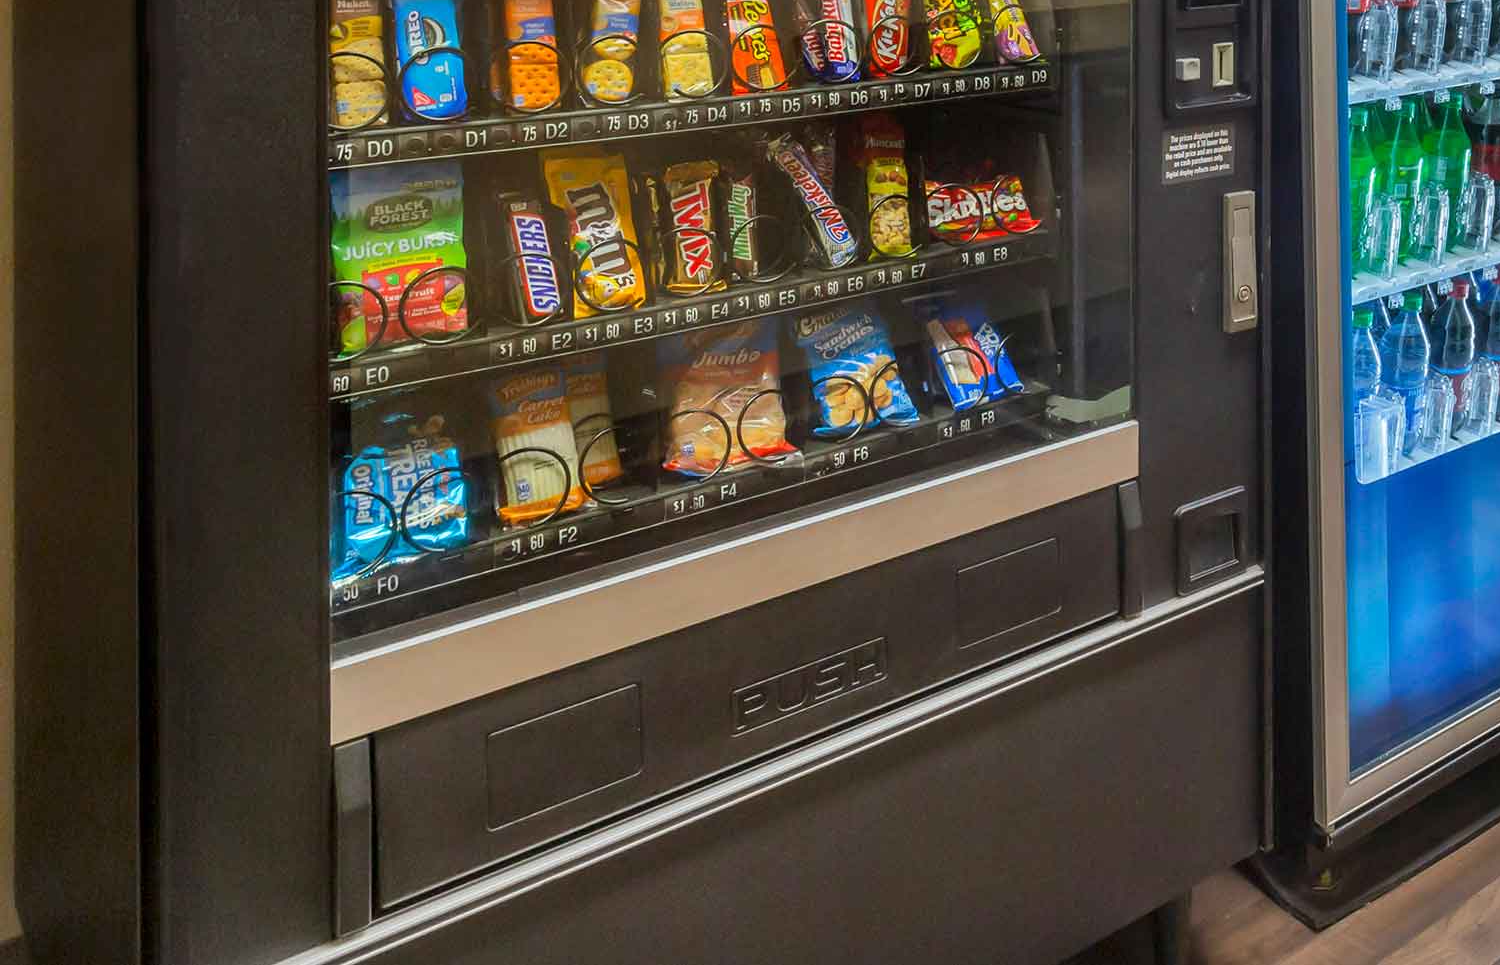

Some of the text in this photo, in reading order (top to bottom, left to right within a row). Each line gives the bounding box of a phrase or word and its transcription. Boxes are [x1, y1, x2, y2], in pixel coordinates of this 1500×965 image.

[408, 10, 430, 65] OREO
[975, 77, 990, 90] D8
[1032, 70, 1047, 83] D9
[850, 90, 868, 106] D6
[914, 83, 930, 98] D7
[782, 97, 800, 113] D5
[628, 115, 649, 130] D3
[707, 106, 727, 122] D4
[466, 131, 488, 148] D1
[546, 123, 567, 139] D2
[367, 141, 393, 158] D0
[374, 199, 425, 215] BLACK
[370, 209, 429, 226] FOREST
[671, 183, 713, 278] TWIX
[993, 247, 1008, 261] E8
[911, 264, 926, 280] E7
[848, 276, 863, 292] E6
[779, 290, 796, 306] E5
[711, 302, 729, 319] E4
[634, 316, 653, 333] E3
[551, 332, 572, 350] E2
[814, 315, 873, 352] Sandwich
[691, 348, 761, 369] Jumbo
[366, 366, 389, 385] E0
[981, 411, 995, 425] F8
[853, 446, 868, 463] F6
[721, 483, 737, 500] F4
[559, 526, 577, 545] F2
[377, 574, 399, 595] F0
